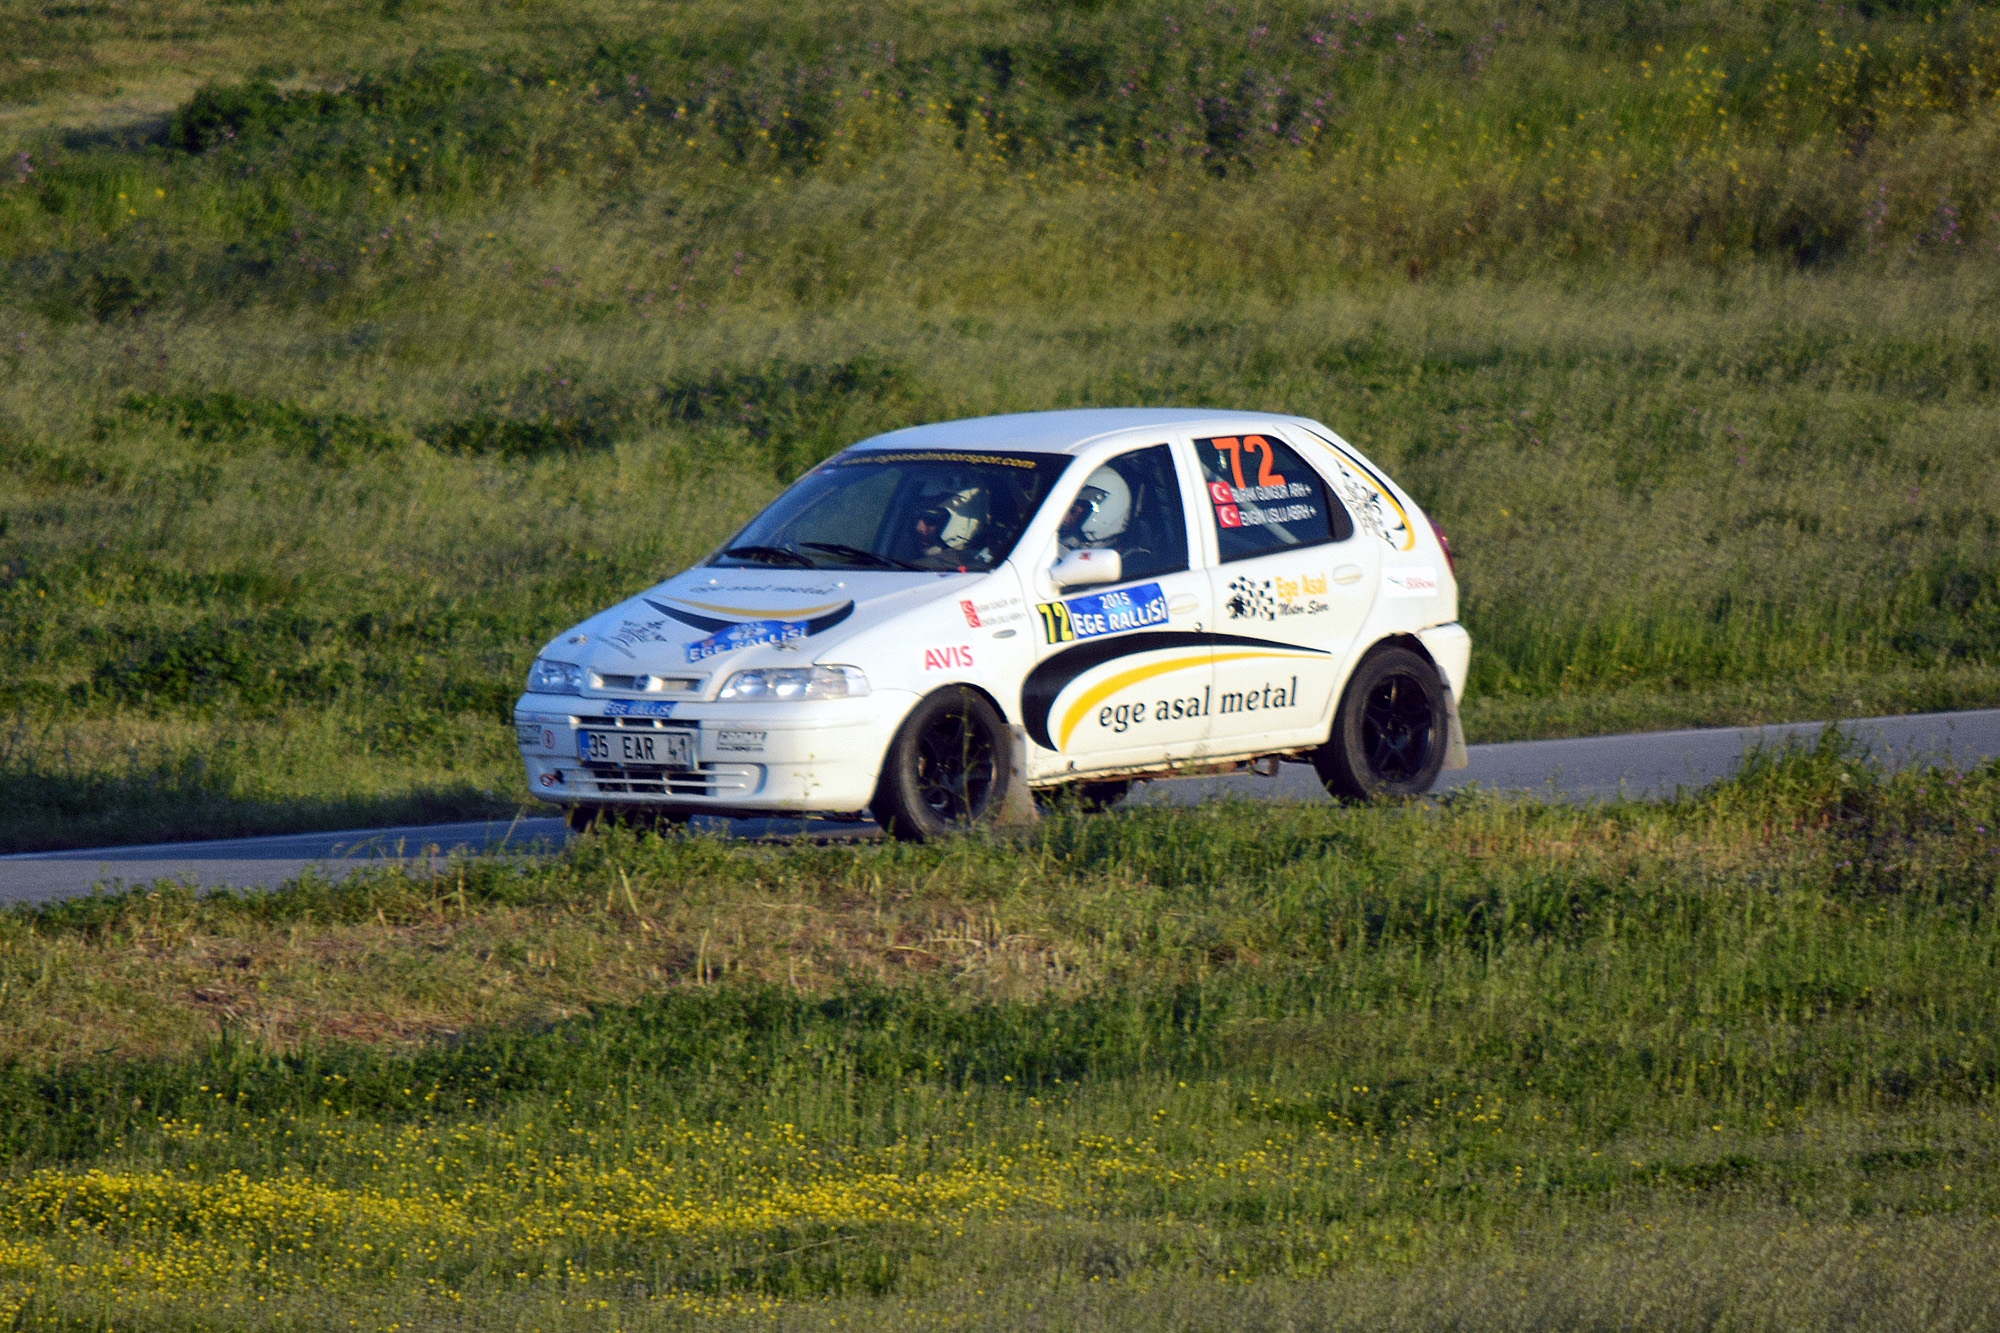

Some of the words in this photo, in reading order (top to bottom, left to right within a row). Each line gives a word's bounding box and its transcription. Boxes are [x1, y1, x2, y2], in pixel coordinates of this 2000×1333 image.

[1211, 435, 1286, 489] 72
[1098, 592, 1131, 610] 2015
[1275, 576, 1299, 603] Ege
[1301, 572, 1328, 596] Asal
[1038, 602, 1074, 644] 72
[1072, 613, 1107, 635] EGE
[689, 644, 726, 662] EGE
[925, 645, 974, 671] AVIS
[1098, 701, 1146, 733] ege
[1155, 684, 1211, 721] asal
[1219, 675, 1297, 714] metal
[589, 733, 609, 758] 35
[622, 736, 656, 761] EAR
